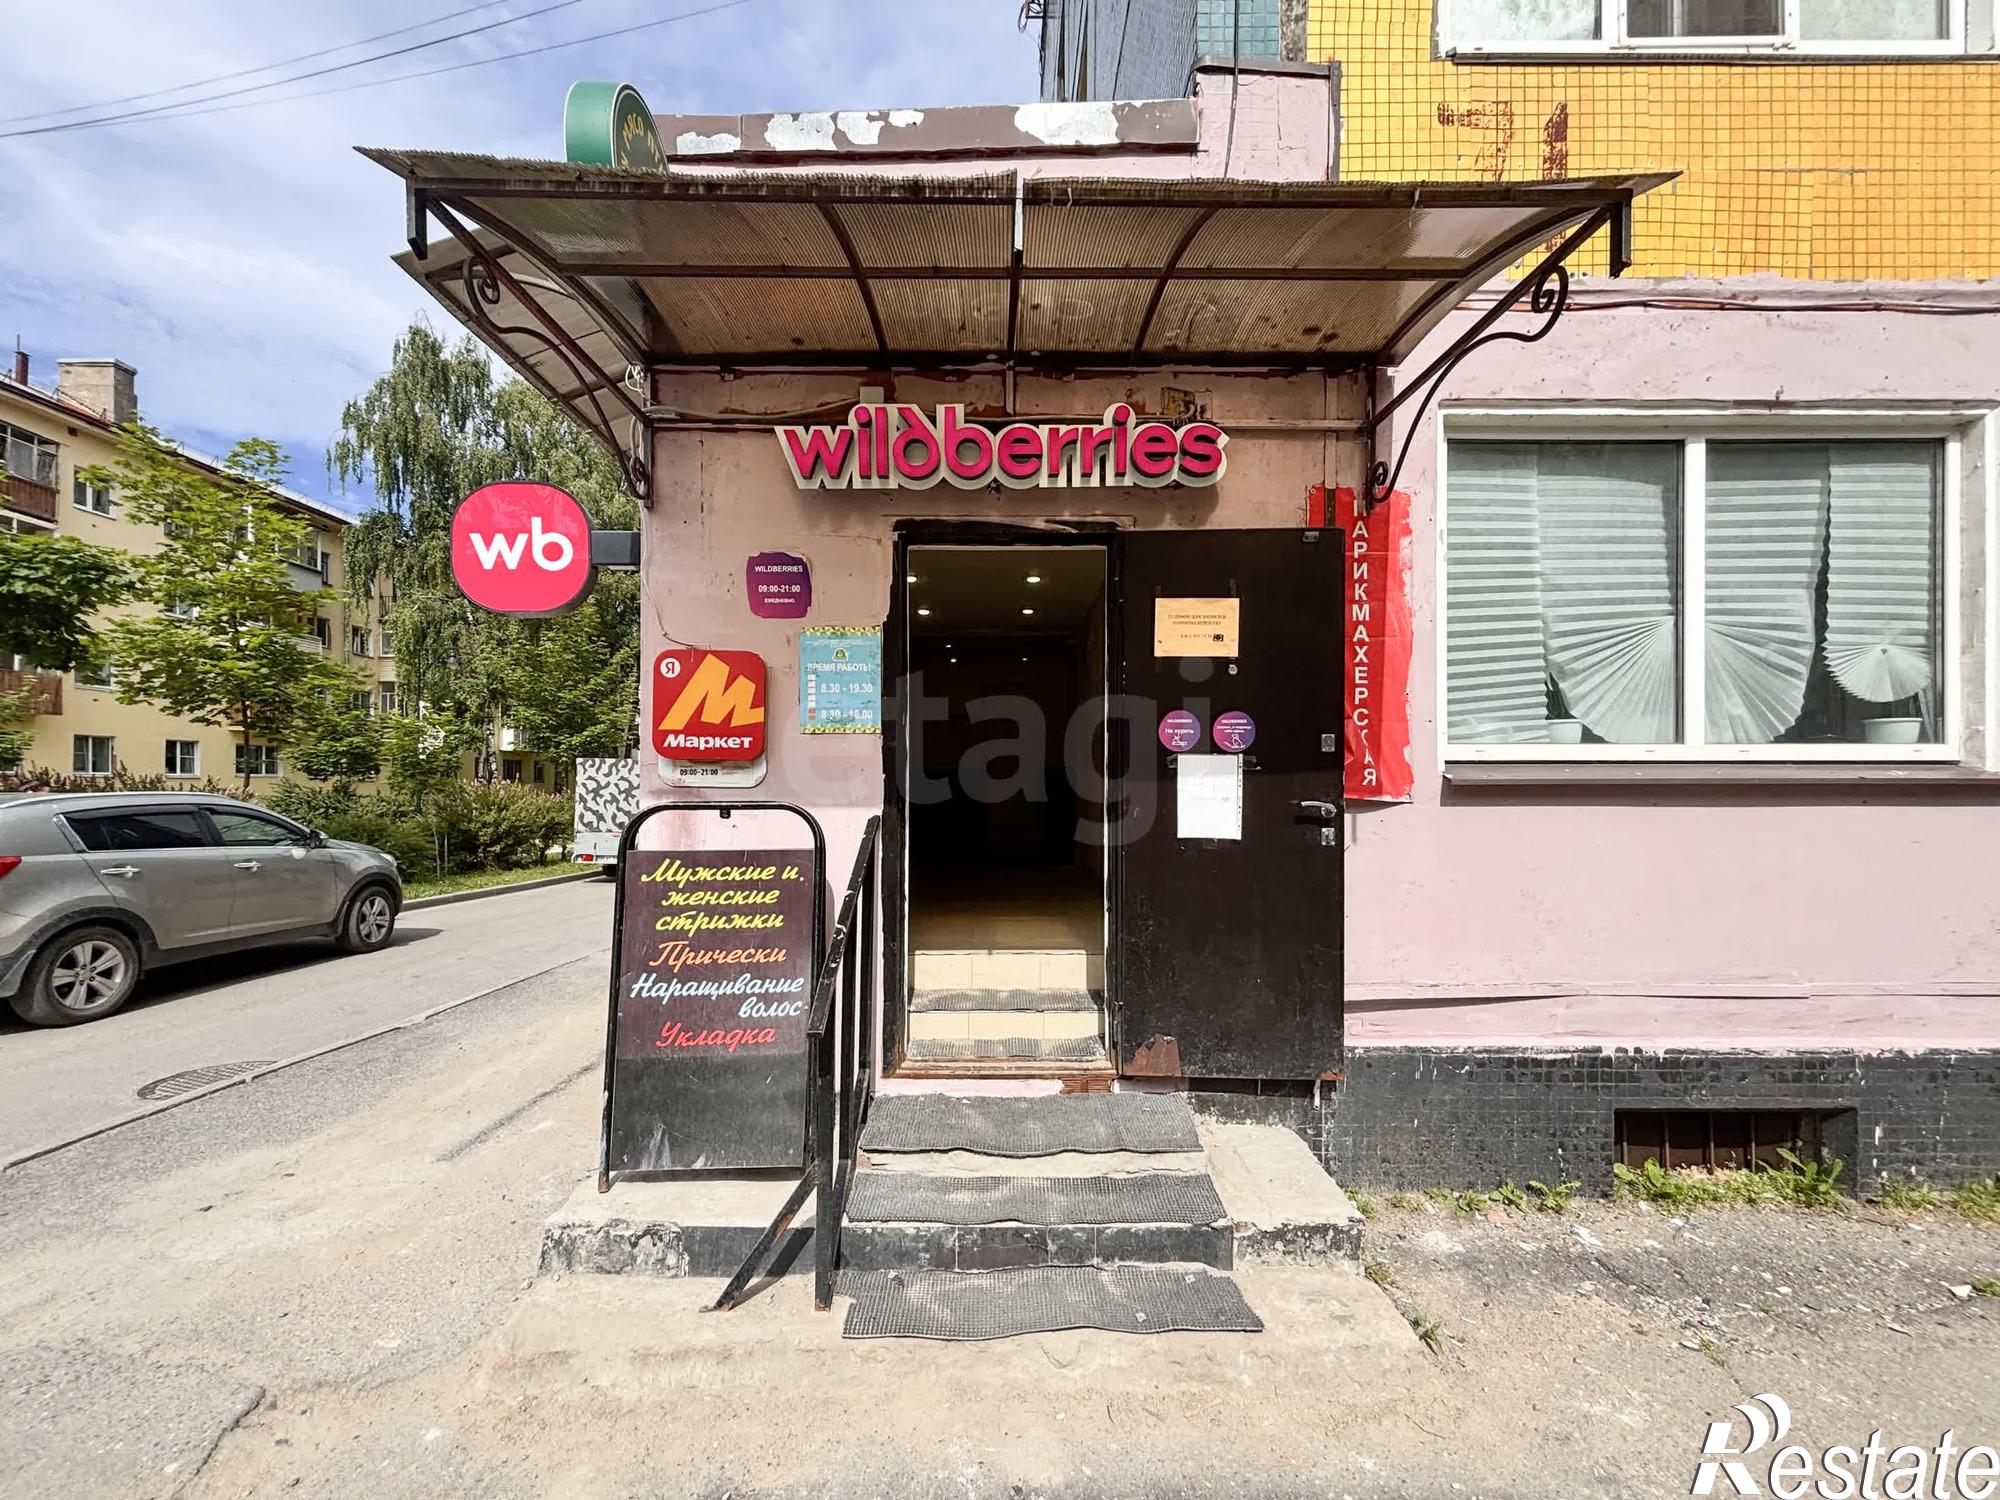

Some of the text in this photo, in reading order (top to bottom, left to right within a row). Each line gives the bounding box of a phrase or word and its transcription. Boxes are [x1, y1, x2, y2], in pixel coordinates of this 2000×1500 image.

[779, 402, 1226, 483] wildberries
[469, 517, 574, 571] wb
[754, 565, 803, 573] WILDBERRIES
[758, 584, 801, 593] 09:00-21:00
[820, 682, 841, 694] 8.30
[848, 682, 873, 694] 19.30
[663, 733, 754, 751] Маркет
[679, 768, 719, 776] 09:00-21:00
[640, 858, 777, 889] Мужские
[661, 888, 781, 906] женские
[655, 910, 784, 937] стрижки
[649, 940, 787, 973] Прически
[629, 972, 805, 1005] Наращивание
[738, 997, 802, 1018] волос
[655, 1021, 776, 1053] Укладка
